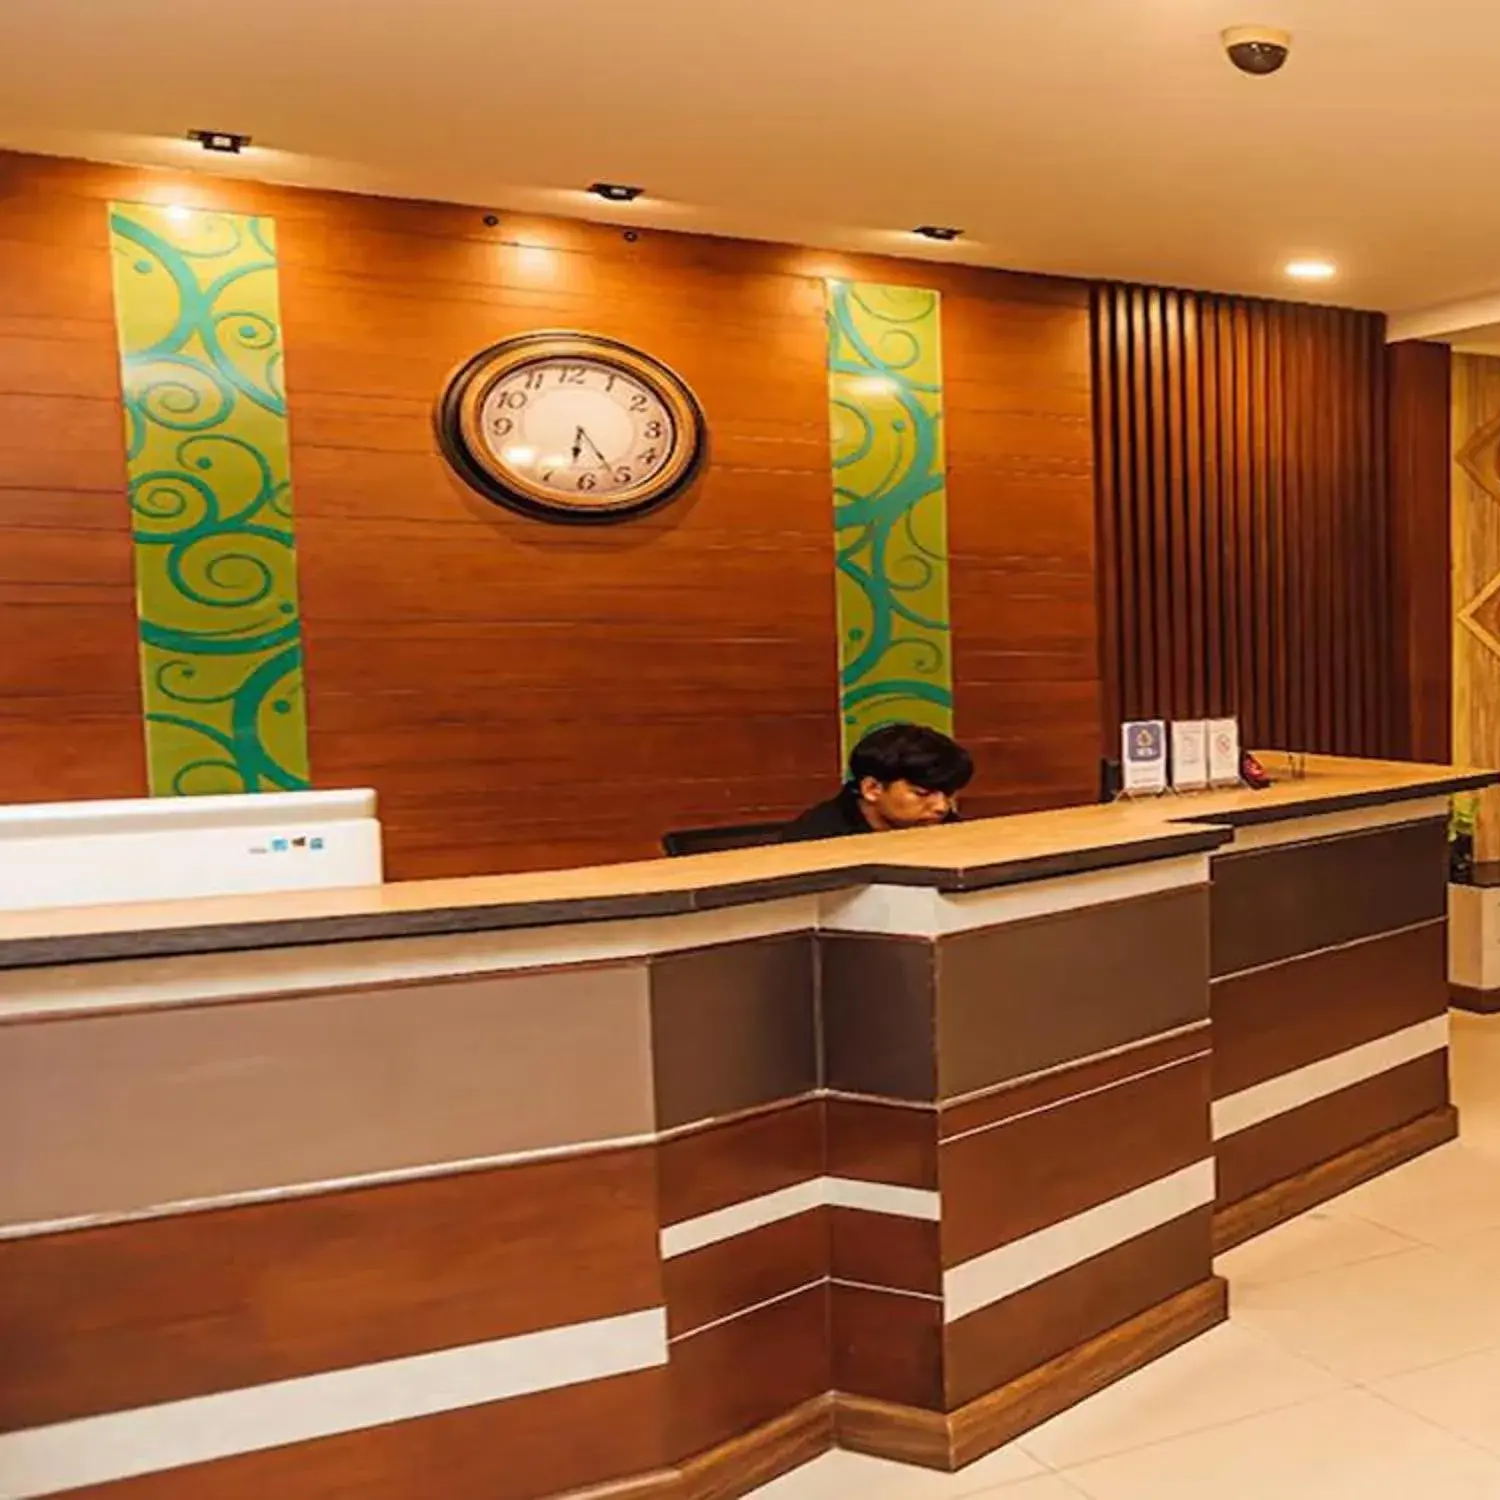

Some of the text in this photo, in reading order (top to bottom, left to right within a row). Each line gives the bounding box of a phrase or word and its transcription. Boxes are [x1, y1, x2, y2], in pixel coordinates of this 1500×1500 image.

[525, 372, 543, 389] 11
[559, 368, 587, 385] 12
[606, 374, 616, 391] 1
[498, 391, 527, 409] 10
[631, 394, 647, 412] 2
[494, 418, 513, 436] 9
[645, 421, 661, 439] 3
[638, 447, 656, 464] 4
[577, 472, 595, 491] 6
[613, 466, 631, 484] 5
